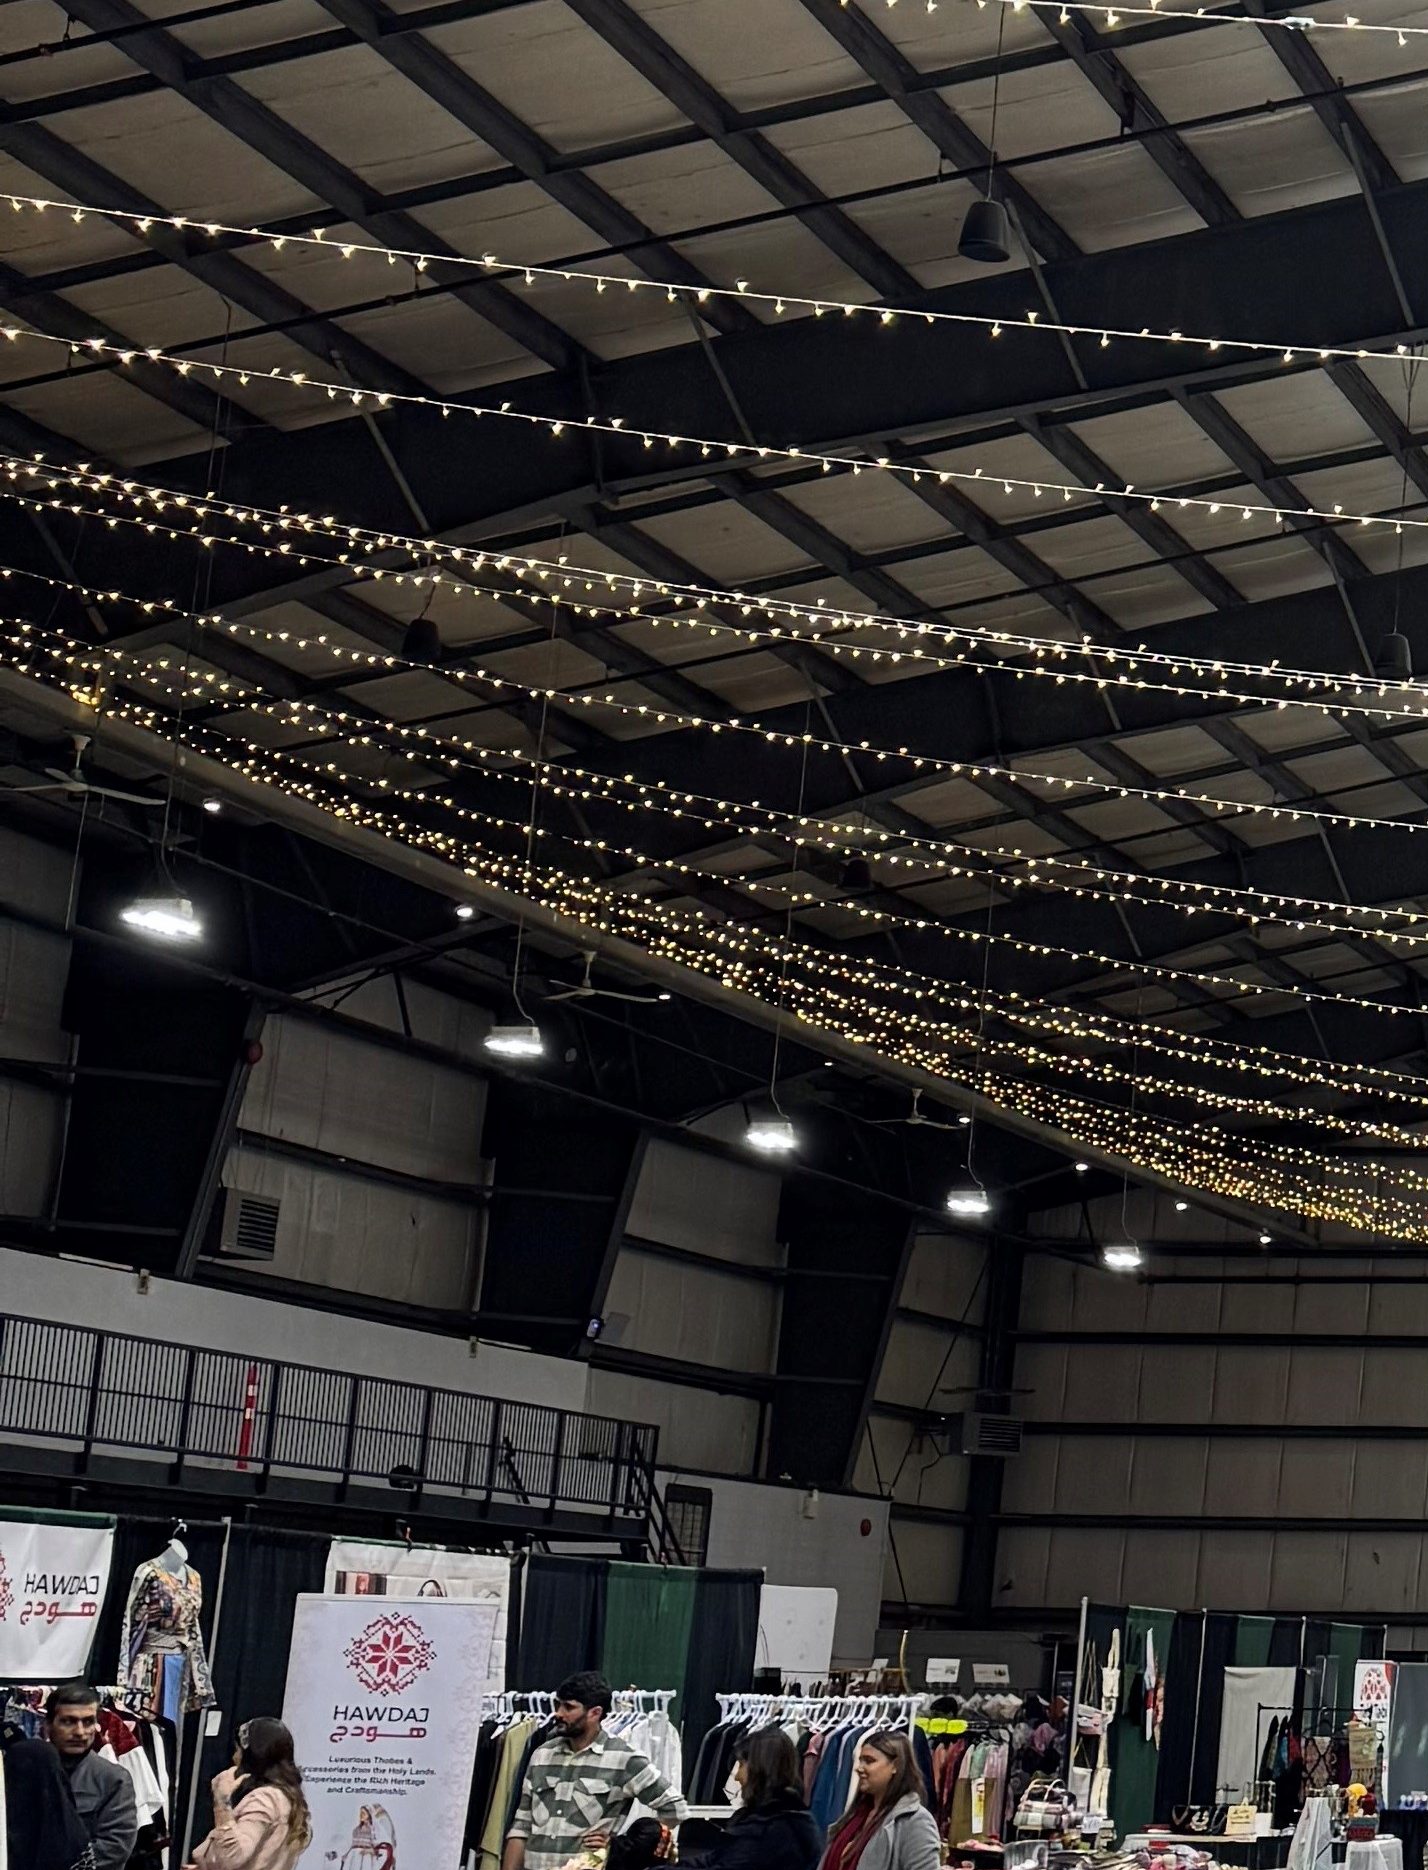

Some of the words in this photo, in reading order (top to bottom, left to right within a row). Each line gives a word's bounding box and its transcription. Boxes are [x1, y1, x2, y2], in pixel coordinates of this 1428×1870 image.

[24, 1573, 99, 1595] HAWDAJ
[333, 1705, 430, 1722] HAWDAJ
[354, 1776, 368, 1784] the
[391, 1778, 425, 1786] Heritage
